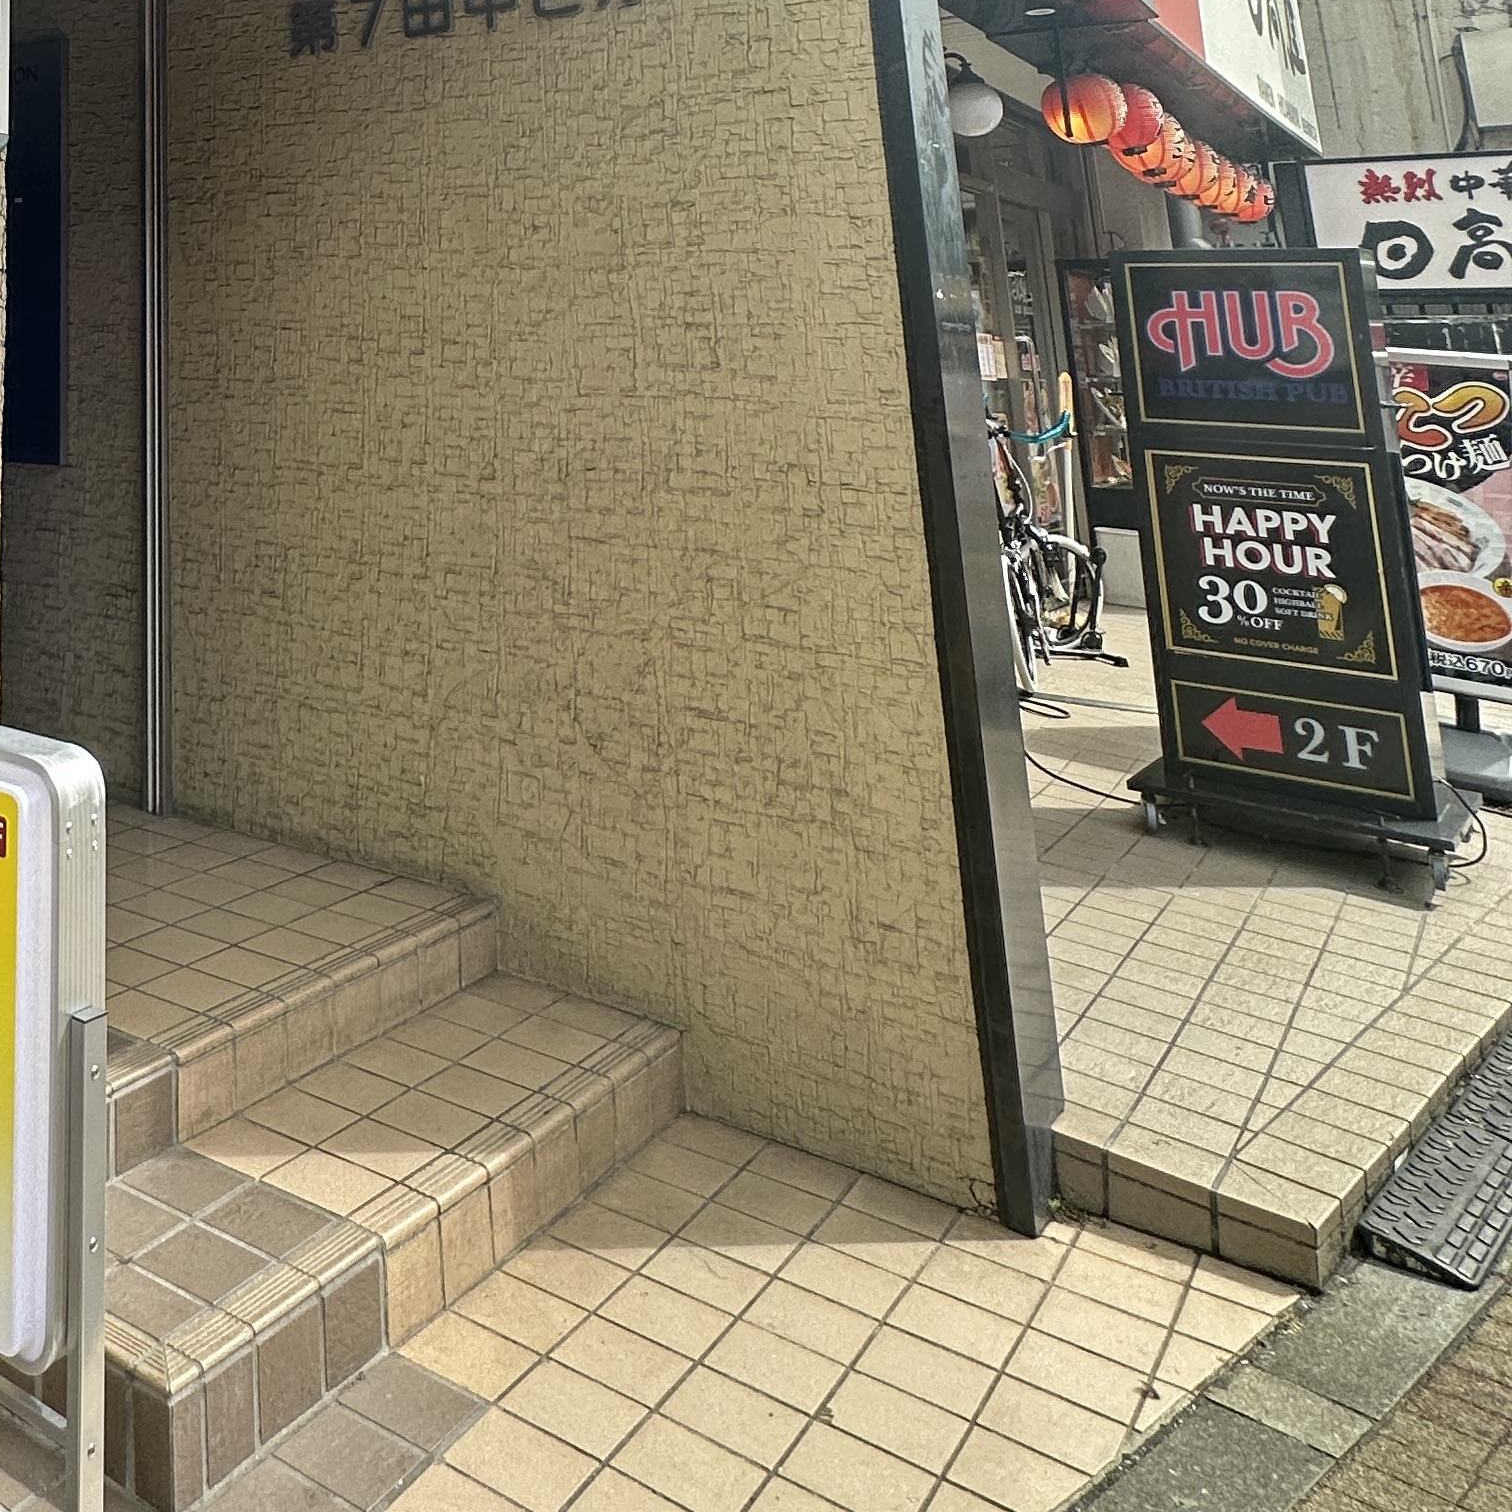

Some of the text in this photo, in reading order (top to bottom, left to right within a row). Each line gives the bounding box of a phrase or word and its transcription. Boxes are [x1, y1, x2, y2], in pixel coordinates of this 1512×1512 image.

[1147, 290, 1335, 379] HUB
[1158, 378, 1349, 405] BRITISH PUB
[1191, 503, 1337, 545] HAPPY
[1202, 536, 1337, 579] HOUR
[1197, 575, 1269, 625] 30
[1294, 716, 1380, 771] 2F
